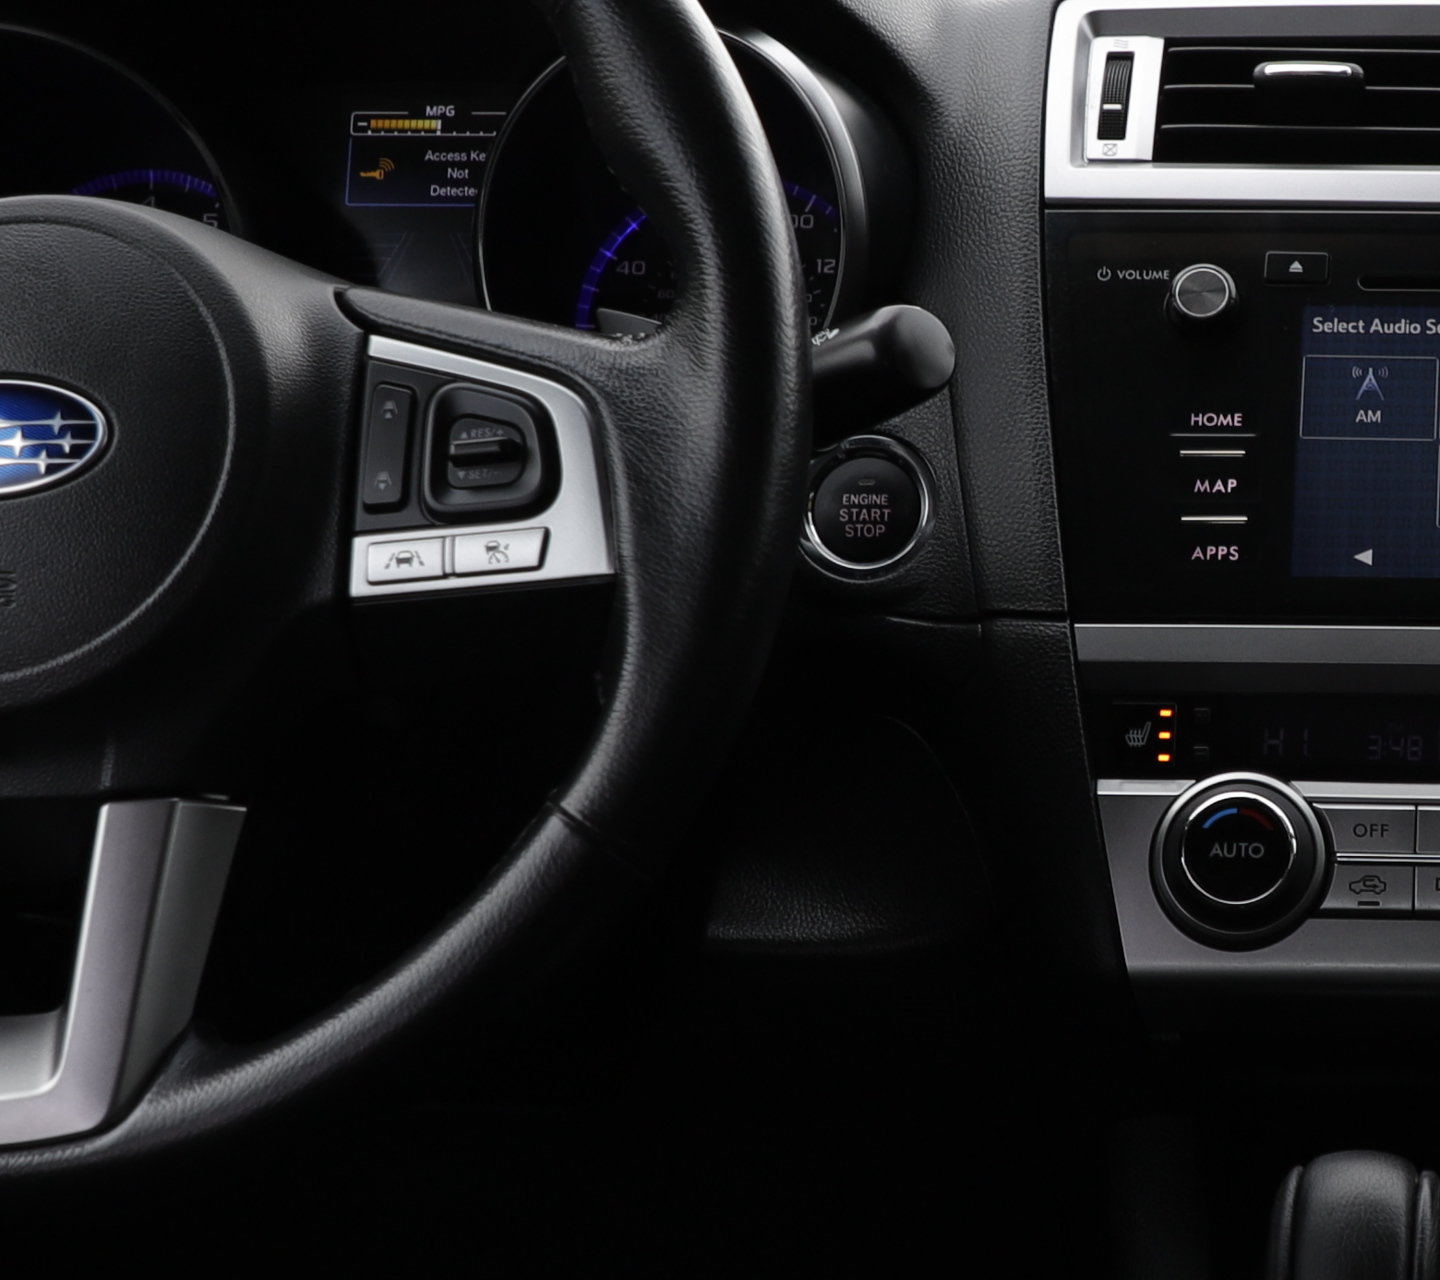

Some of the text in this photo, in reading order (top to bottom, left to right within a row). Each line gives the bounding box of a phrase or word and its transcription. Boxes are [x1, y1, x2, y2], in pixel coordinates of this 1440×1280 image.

[425, 105, 456, 118] MPG
[424, 149, 488, 163] Access Ke
[446, 167, 469, 179] Not
[615, 260, 647, 276] 40
[1116, 269, 1170, 280] VOLUME
[1312, 317, 1365, 334] Select
[1369, 318, 1421, 335] Audio
[1190, 413, 1243, 427] HOME
[1355, 409, 1382, 423] AM
[1193, 478, 1238, 493] MAP
[842, 493, 889, 505] ENGINE
[840, 508, 892, 522] START
[845, 524, 886, 538] STOP
[1191, 545, 1240, 561] APPS
[1353, 823, 1389, 838] OFF
[1210, 842, 1264, 859] AUTO
